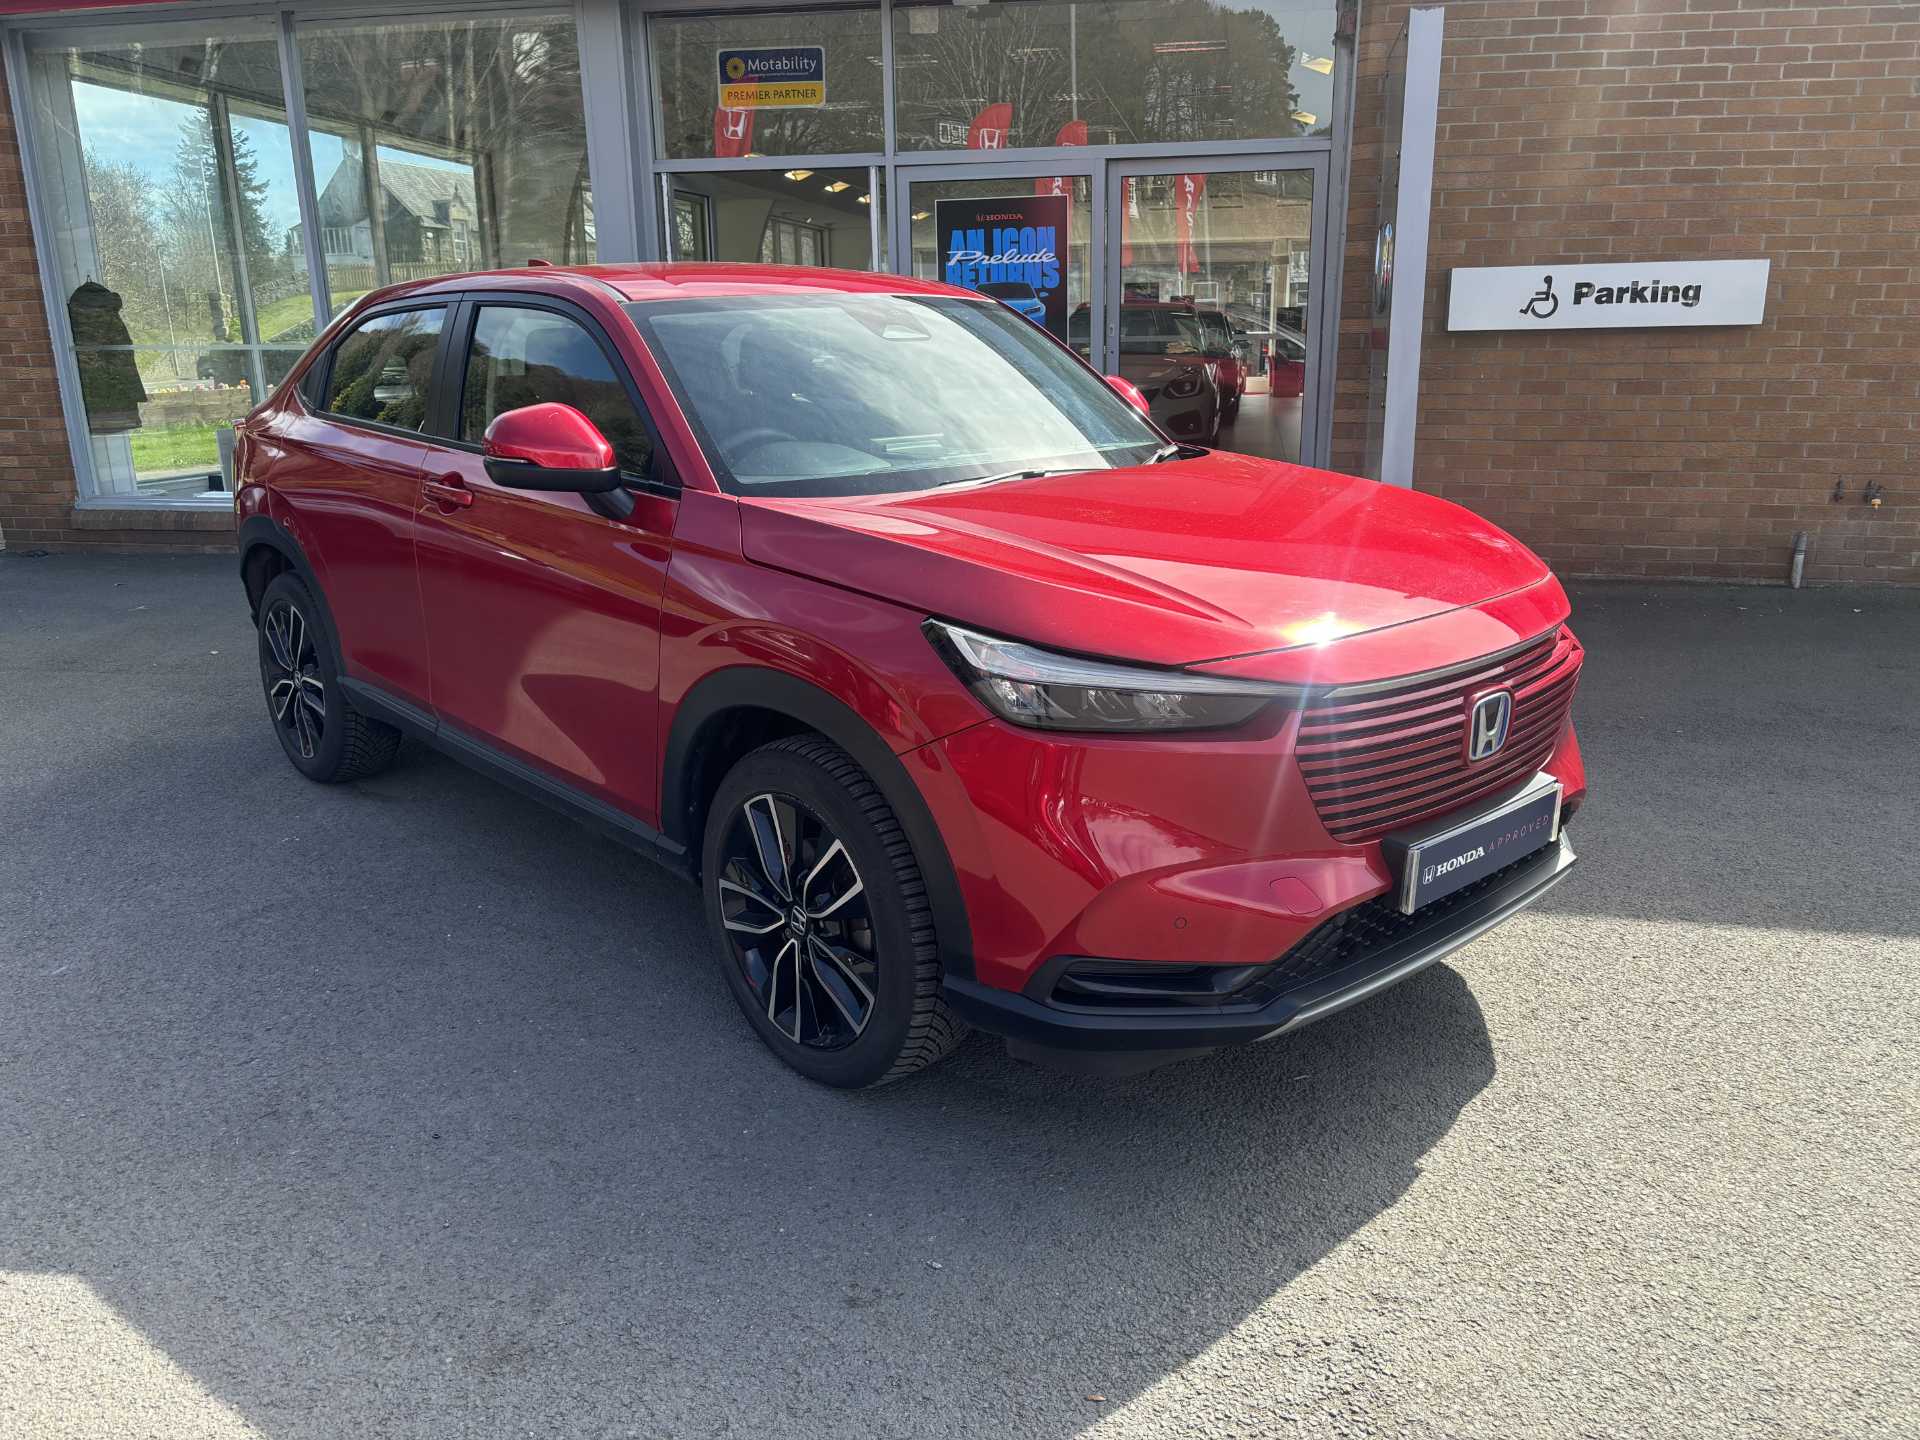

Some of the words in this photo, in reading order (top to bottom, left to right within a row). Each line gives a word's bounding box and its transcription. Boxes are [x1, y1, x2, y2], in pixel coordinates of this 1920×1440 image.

[748, 56, 816, 73] Motability
[728, 90, 770, 101] PREMIER
[773, 89, 816, 99] PARTNER
[986, 213, 1024, 221] HONDA
[951, 229, 985, 261] AN
[993, 227, 1056, 261] ICON
[946, 248, 1056, 266] Prelude
[946, 260, 1060, 289] RETURNS
[1573, 280, 1702, 307] Parking
[1436, 846, 1485, 876] HONDA
[1489, 815, 1550, 851] APPROVED
